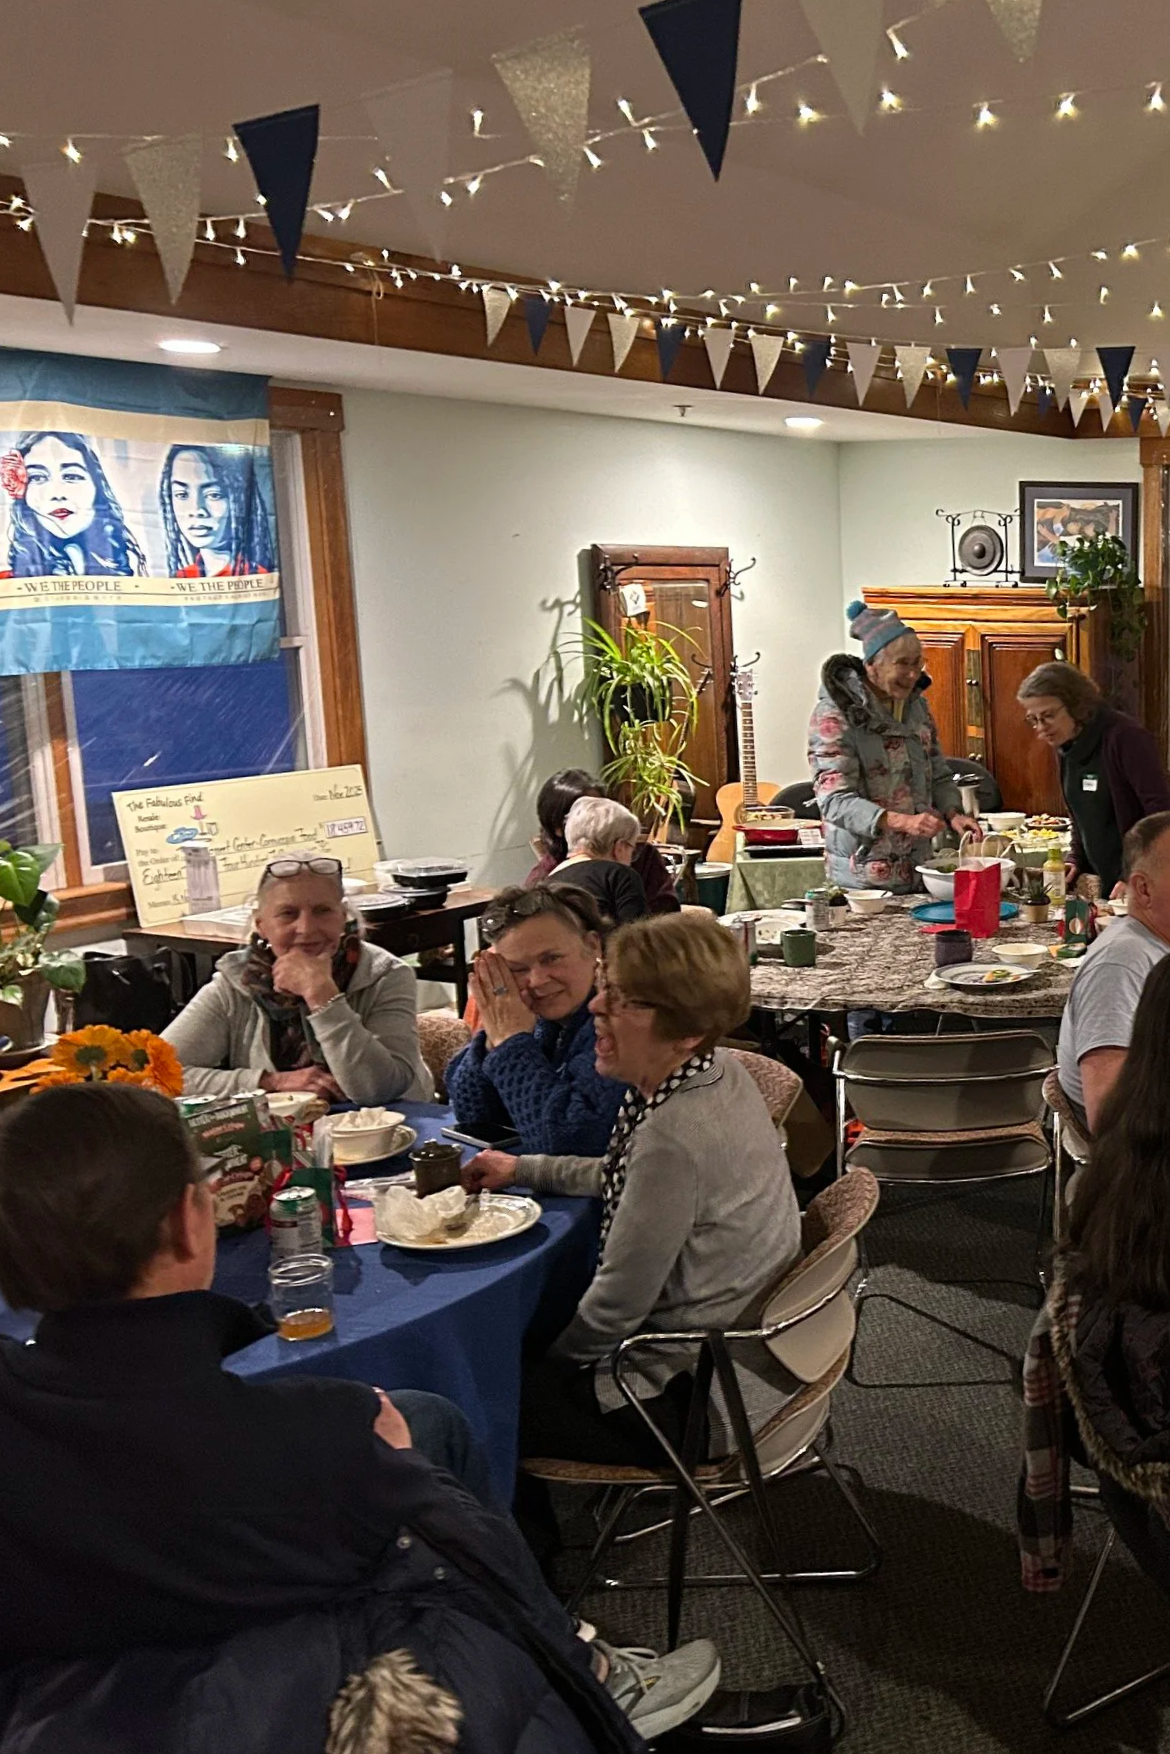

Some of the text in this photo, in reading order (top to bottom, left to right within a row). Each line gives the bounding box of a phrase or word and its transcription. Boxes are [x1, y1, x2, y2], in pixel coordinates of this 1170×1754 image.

[24, 581, 122, 593] WE THE PEOPLE
[176, 579, 263, 592] WE THE PEOPLE
[127, 792, 204, 812] The Fabulous Find
